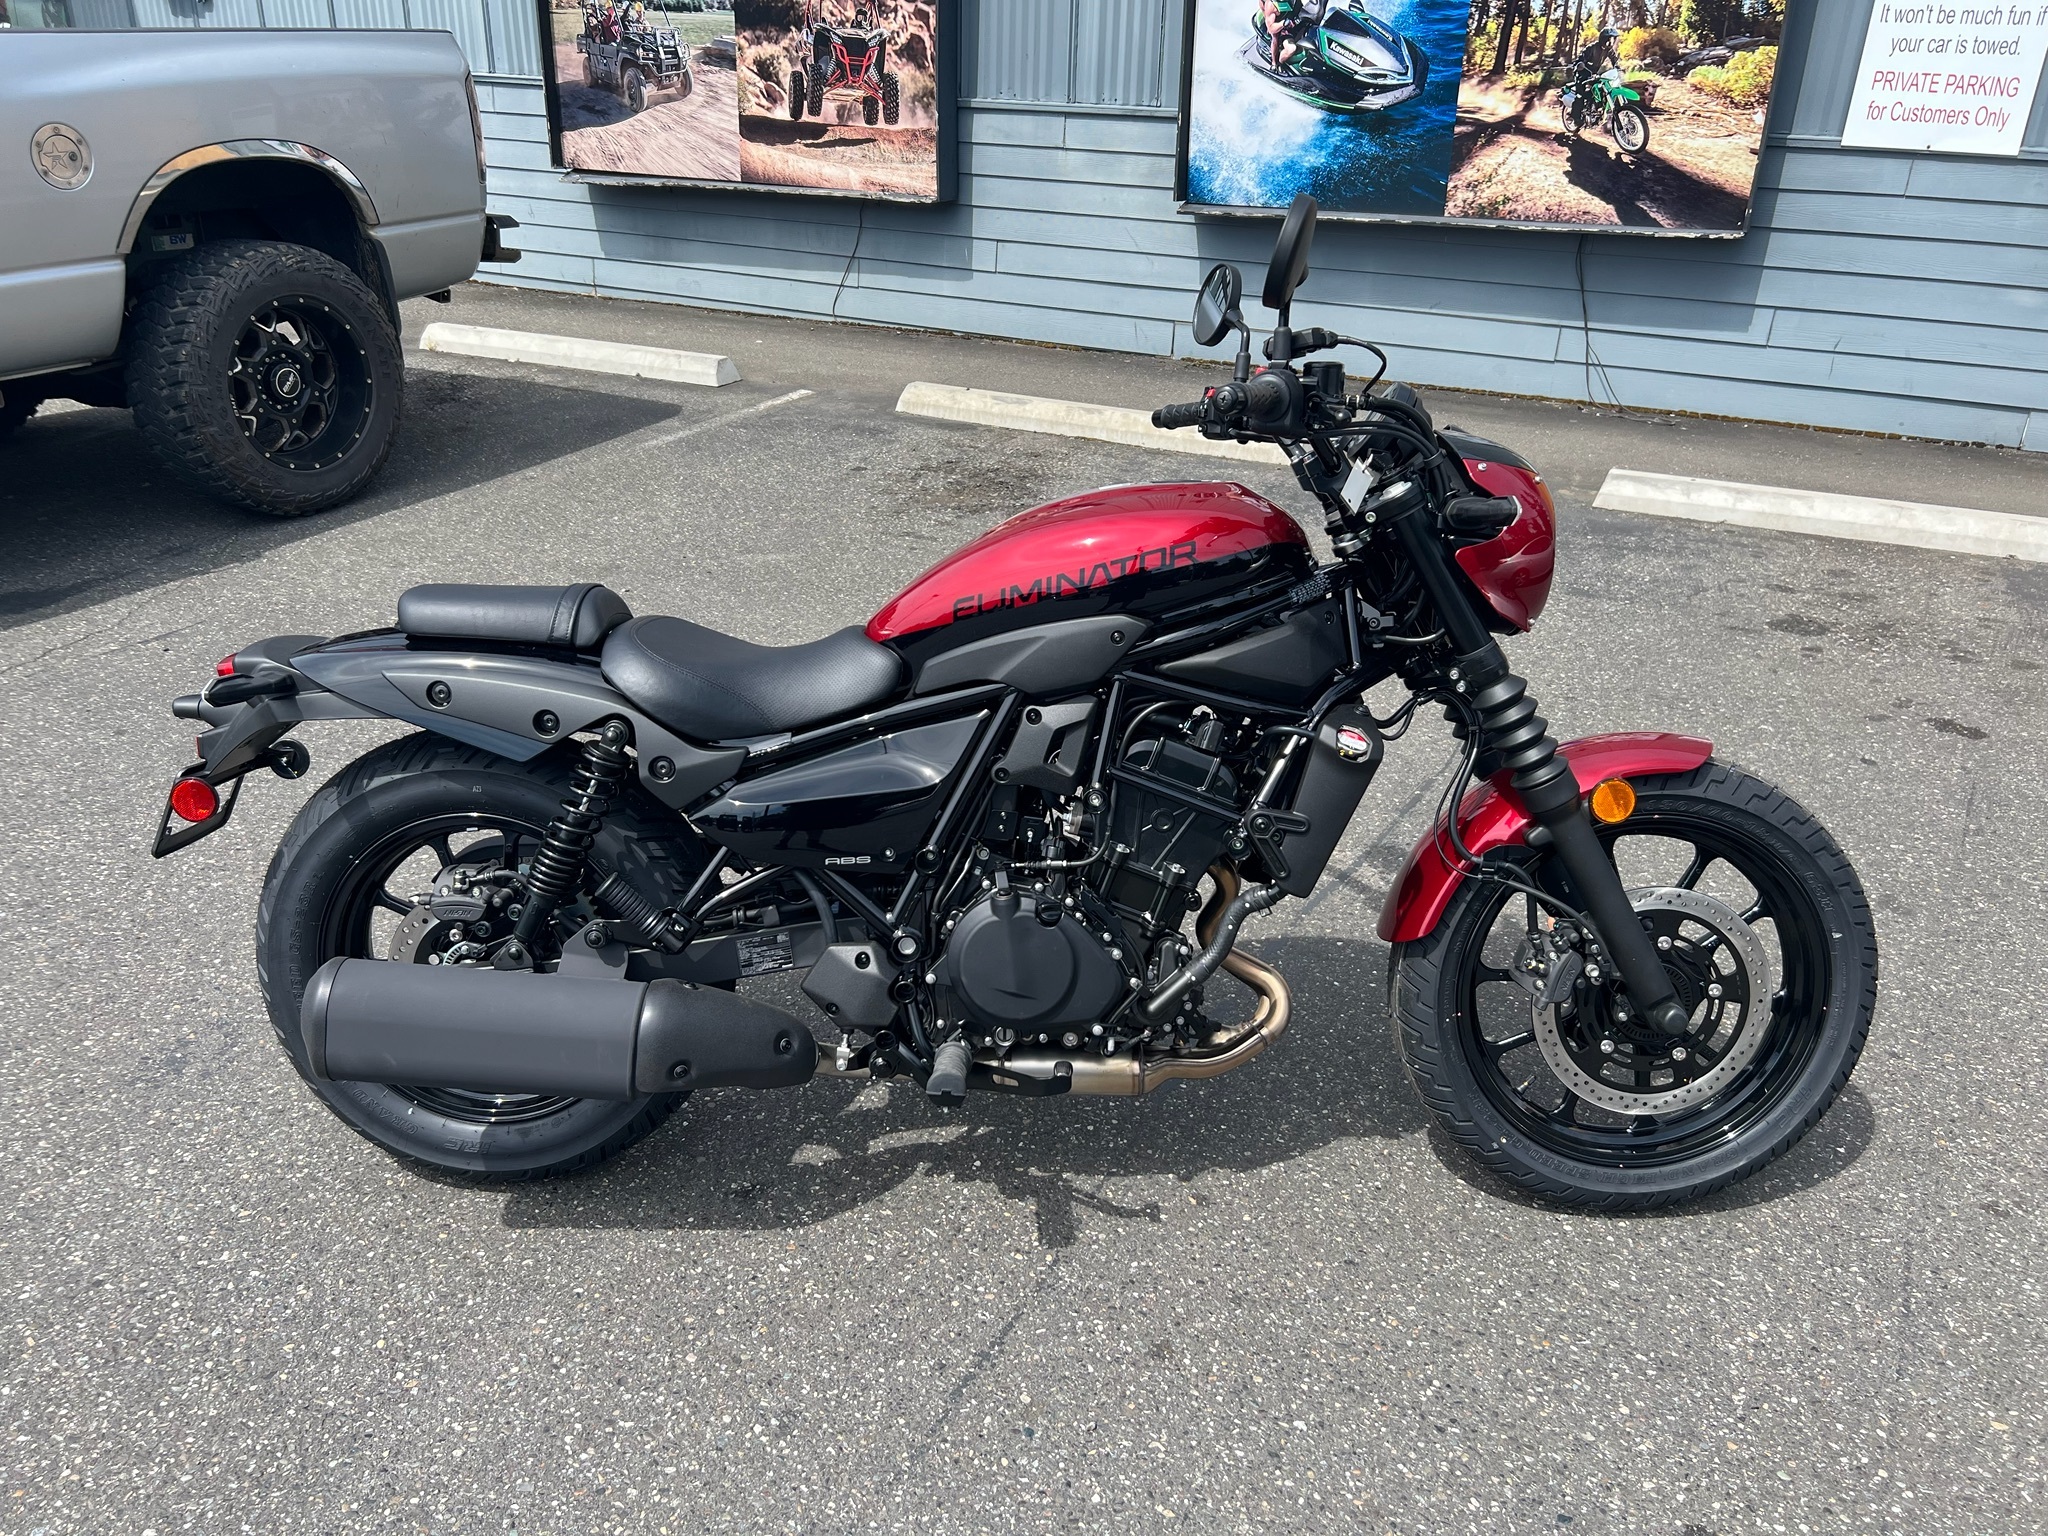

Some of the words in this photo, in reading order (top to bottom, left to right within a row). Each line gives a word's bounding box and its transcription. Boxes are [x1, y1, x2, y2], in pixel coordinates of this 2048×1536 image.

[1879, 3, 1890, 24] It
[1894, 4, 1933, 25] won't
[1936, 5, 1956, 25] be
[1960, 7, 2002, 26] much
[2006, 5, 2032, 26] fun
[1330, 41, 1364, 66] Kawasaki
[1889, 36, 1924, 57] your
[1927, 37, 1953, 54] car
[1955, 34, 1968, 55] is
[1972, 36, 2021, 56] towed.
[1871, 70, 1942, 94] PRIVATE
[1944, 74, 2021, 98] PARKING
[1866, 100, 1887, 121] for
[1890, 101, 1970, 126] Customers
[1974, 105, 2011, 133] Only
[953, 541, 1198, 620] ELIMINATOR
[825, 855, 871, 866] ABS
